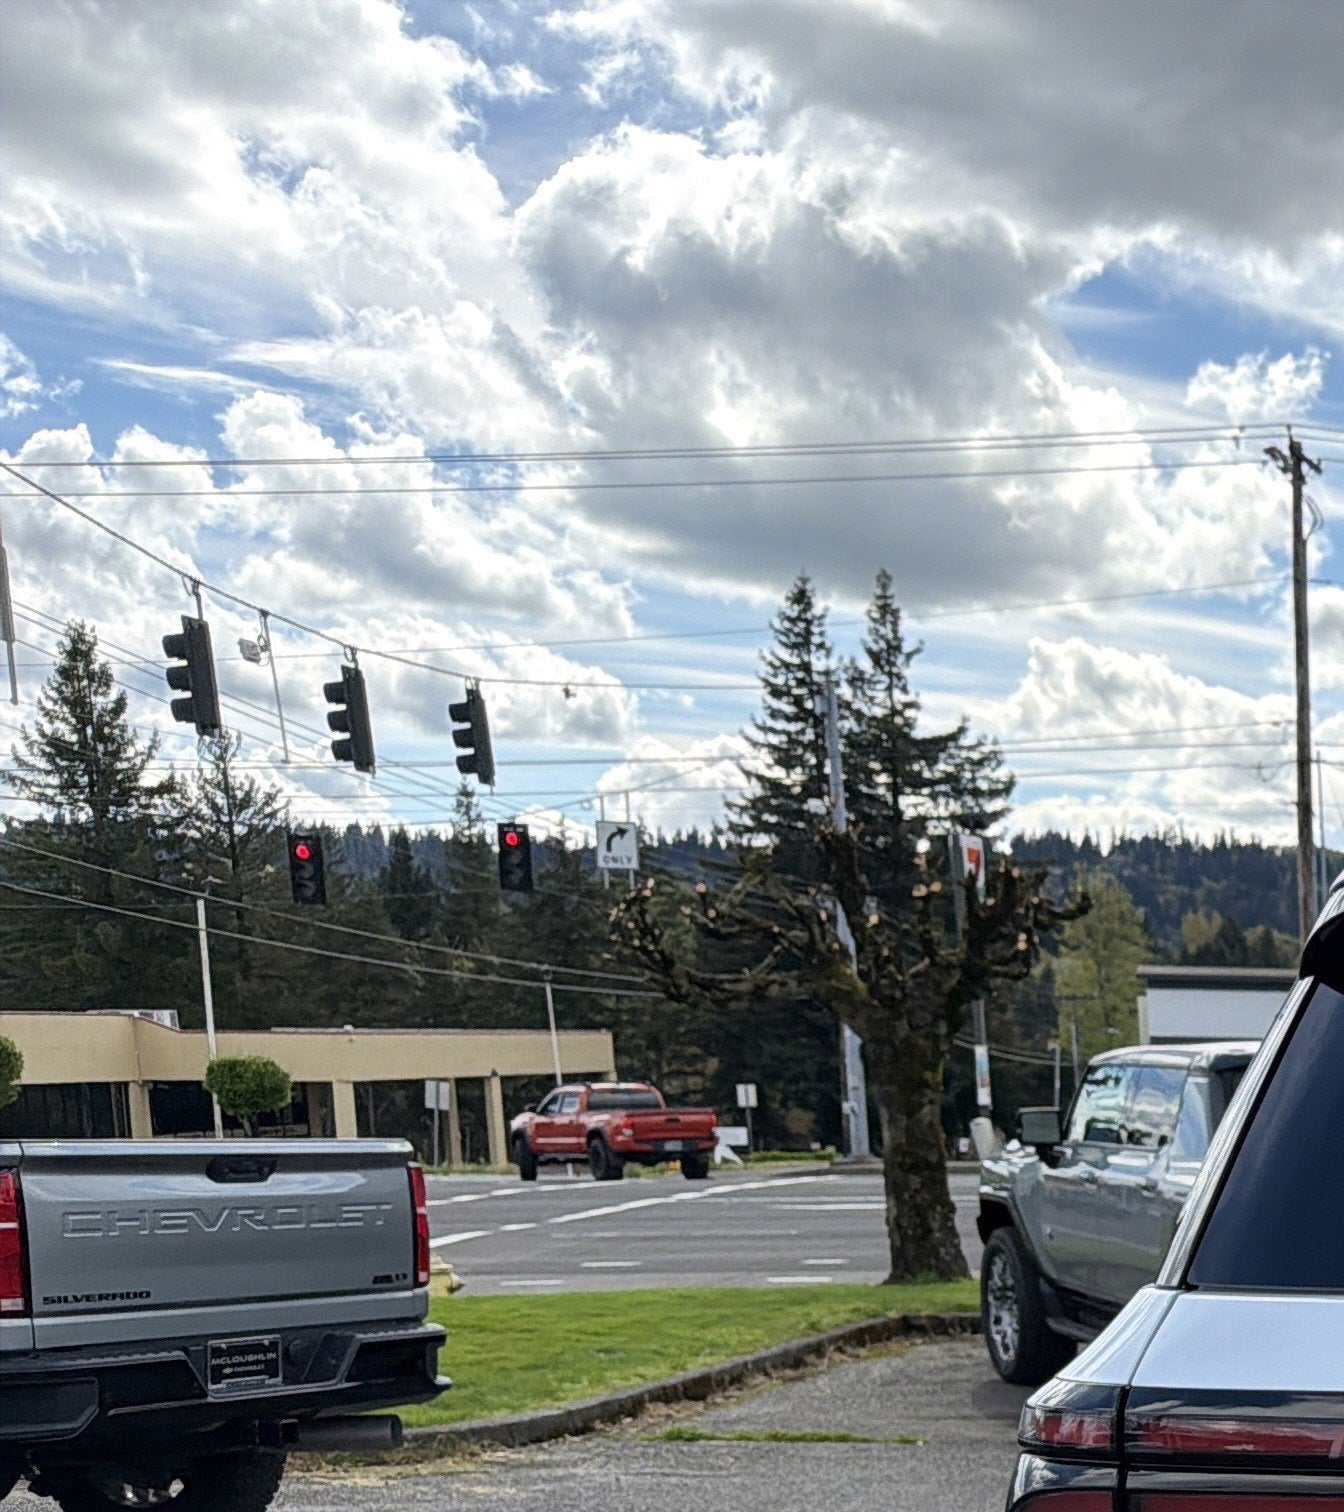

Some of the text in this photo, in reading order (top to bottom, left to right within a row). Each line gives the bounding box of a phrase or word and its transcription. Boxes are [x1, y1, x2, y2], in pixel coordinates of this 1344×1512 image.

[603, 855, 632, 865] ONLY
[62, 1202, 393, 1238] CHEVROLET
[42, 1290, 152, 1306] SILVERADO
[211, 1352, 277, 1366] MCLOUGHLIN
